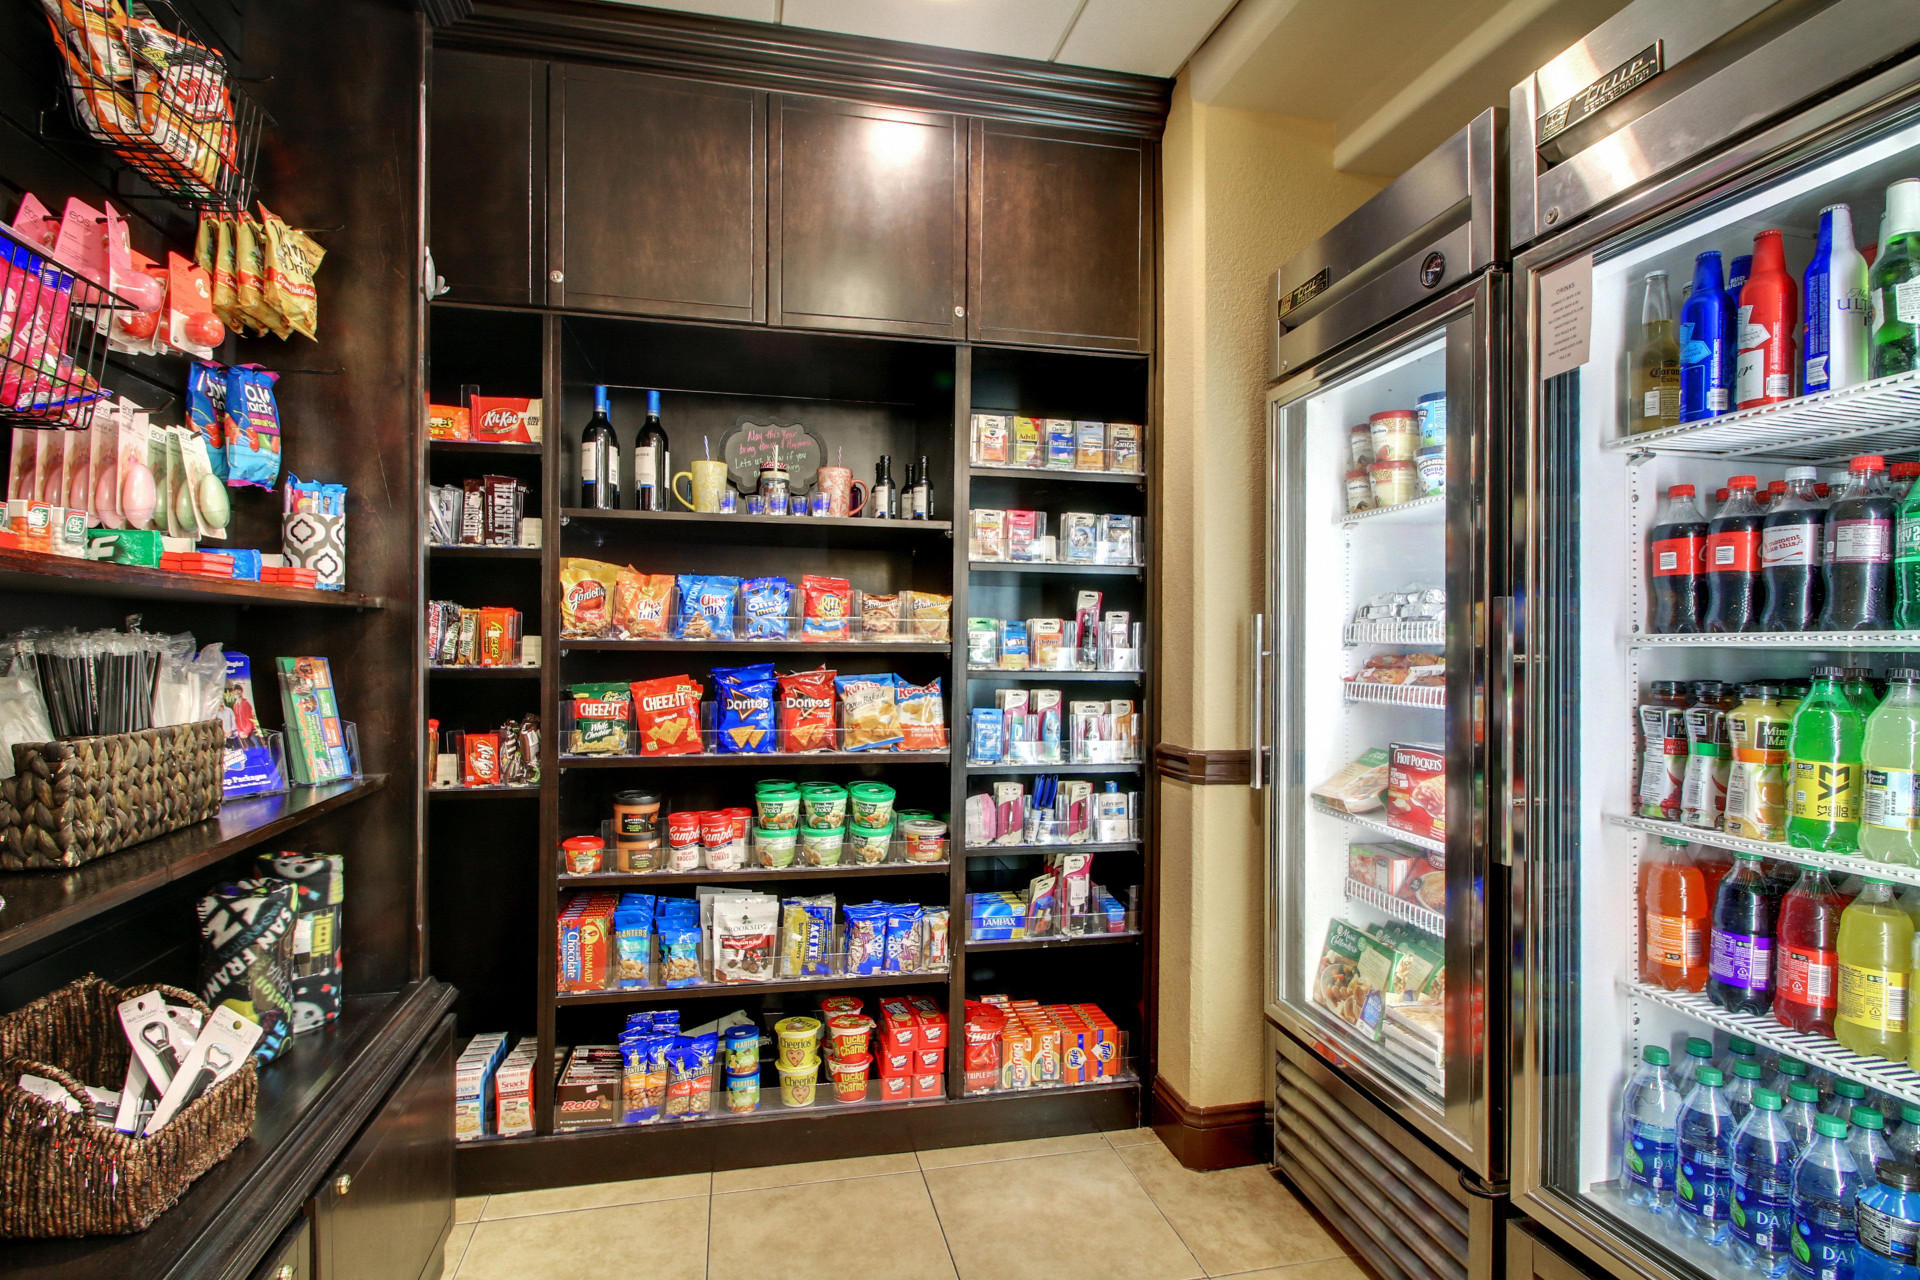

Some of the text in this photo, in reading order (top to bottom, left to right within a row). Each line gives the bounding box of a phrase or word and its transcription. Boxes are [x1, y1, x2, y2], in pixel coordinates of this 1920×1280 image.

[24, 205, 38, 224] eos
[69, 209, 90, 227] eos
[1731, 275, 1746, 284] BUD
[1556, 282, 1575, 295] DRINKS
[1649, 367, 1680, 378] Coron
[96, 404, 109, 416] eos
[121, 404, 133, 415] eos
[151, 432, 165, 443] eos
[179, 431, 191, 443] eos
[765, 429, 780, 439] this
[1114, 440, 1137, 449] Zantac
[796, 452, 807, 461] you
[1769, 534, 1801, 546] moment
[636, 600, 662, 611] Chex
[700, 594, 728, 606] Chex
[748, 600, 782, 612] OREO
[821, 596, 841, 609] RITZ
[490, 620, 504, 658] Rese's
[642, 692, 686, 712] CHEEZ-IT
[786, 697, 832, 709] Doritos
[863, 691, 885, 704] Baked
[580, 703, 621, 716] CHEEZ-IT
[726, 698, 769, 711] Doritos
[590, 719, 609, 732] White
[1397, 752, 1442, 771] HOT POCKETS
[231, 773, 267, 784] Packages
[814, 806, 832, 814] Choice
[858, 806, 875, 814] Choice
[256, 906, 292, 950] SAN
[723, 922, 768, 932] BROOKSIDE
[982, 918, 1016, 927] TAMPAX
[810, 923, 820, 946] ACT
[566, 931, 580, 979] Chocolate
[584, 944, 593, 983] SUN-MAID
[780, 1038, 812, 1048] Cheerios
[843, 1034, 866, 1048] Lucky
[840, 1044, 866, 1057] Charms
[1042, 1035, 1054, 1073] bounce
[1102, 1042, 1111, 1060] Tide
[1013, 1042, 1025, 1080] bounce
[1070, 1049, 1081, 1067] Tide
[785, 1075, 816, 1087] Cheerios
[841, 1072, 865, 1084] Lucky
[967, 1072, 985, 1080] TRIPLE
[457, 1085, 477, 1093] nack
[502, 1080, 526, 1089] Snack
[730, 1079, 756, 1088] PLANTERS
[839, 1082, 867, 1094] Charms
[561, 1099, 599, 1111] Rolo
